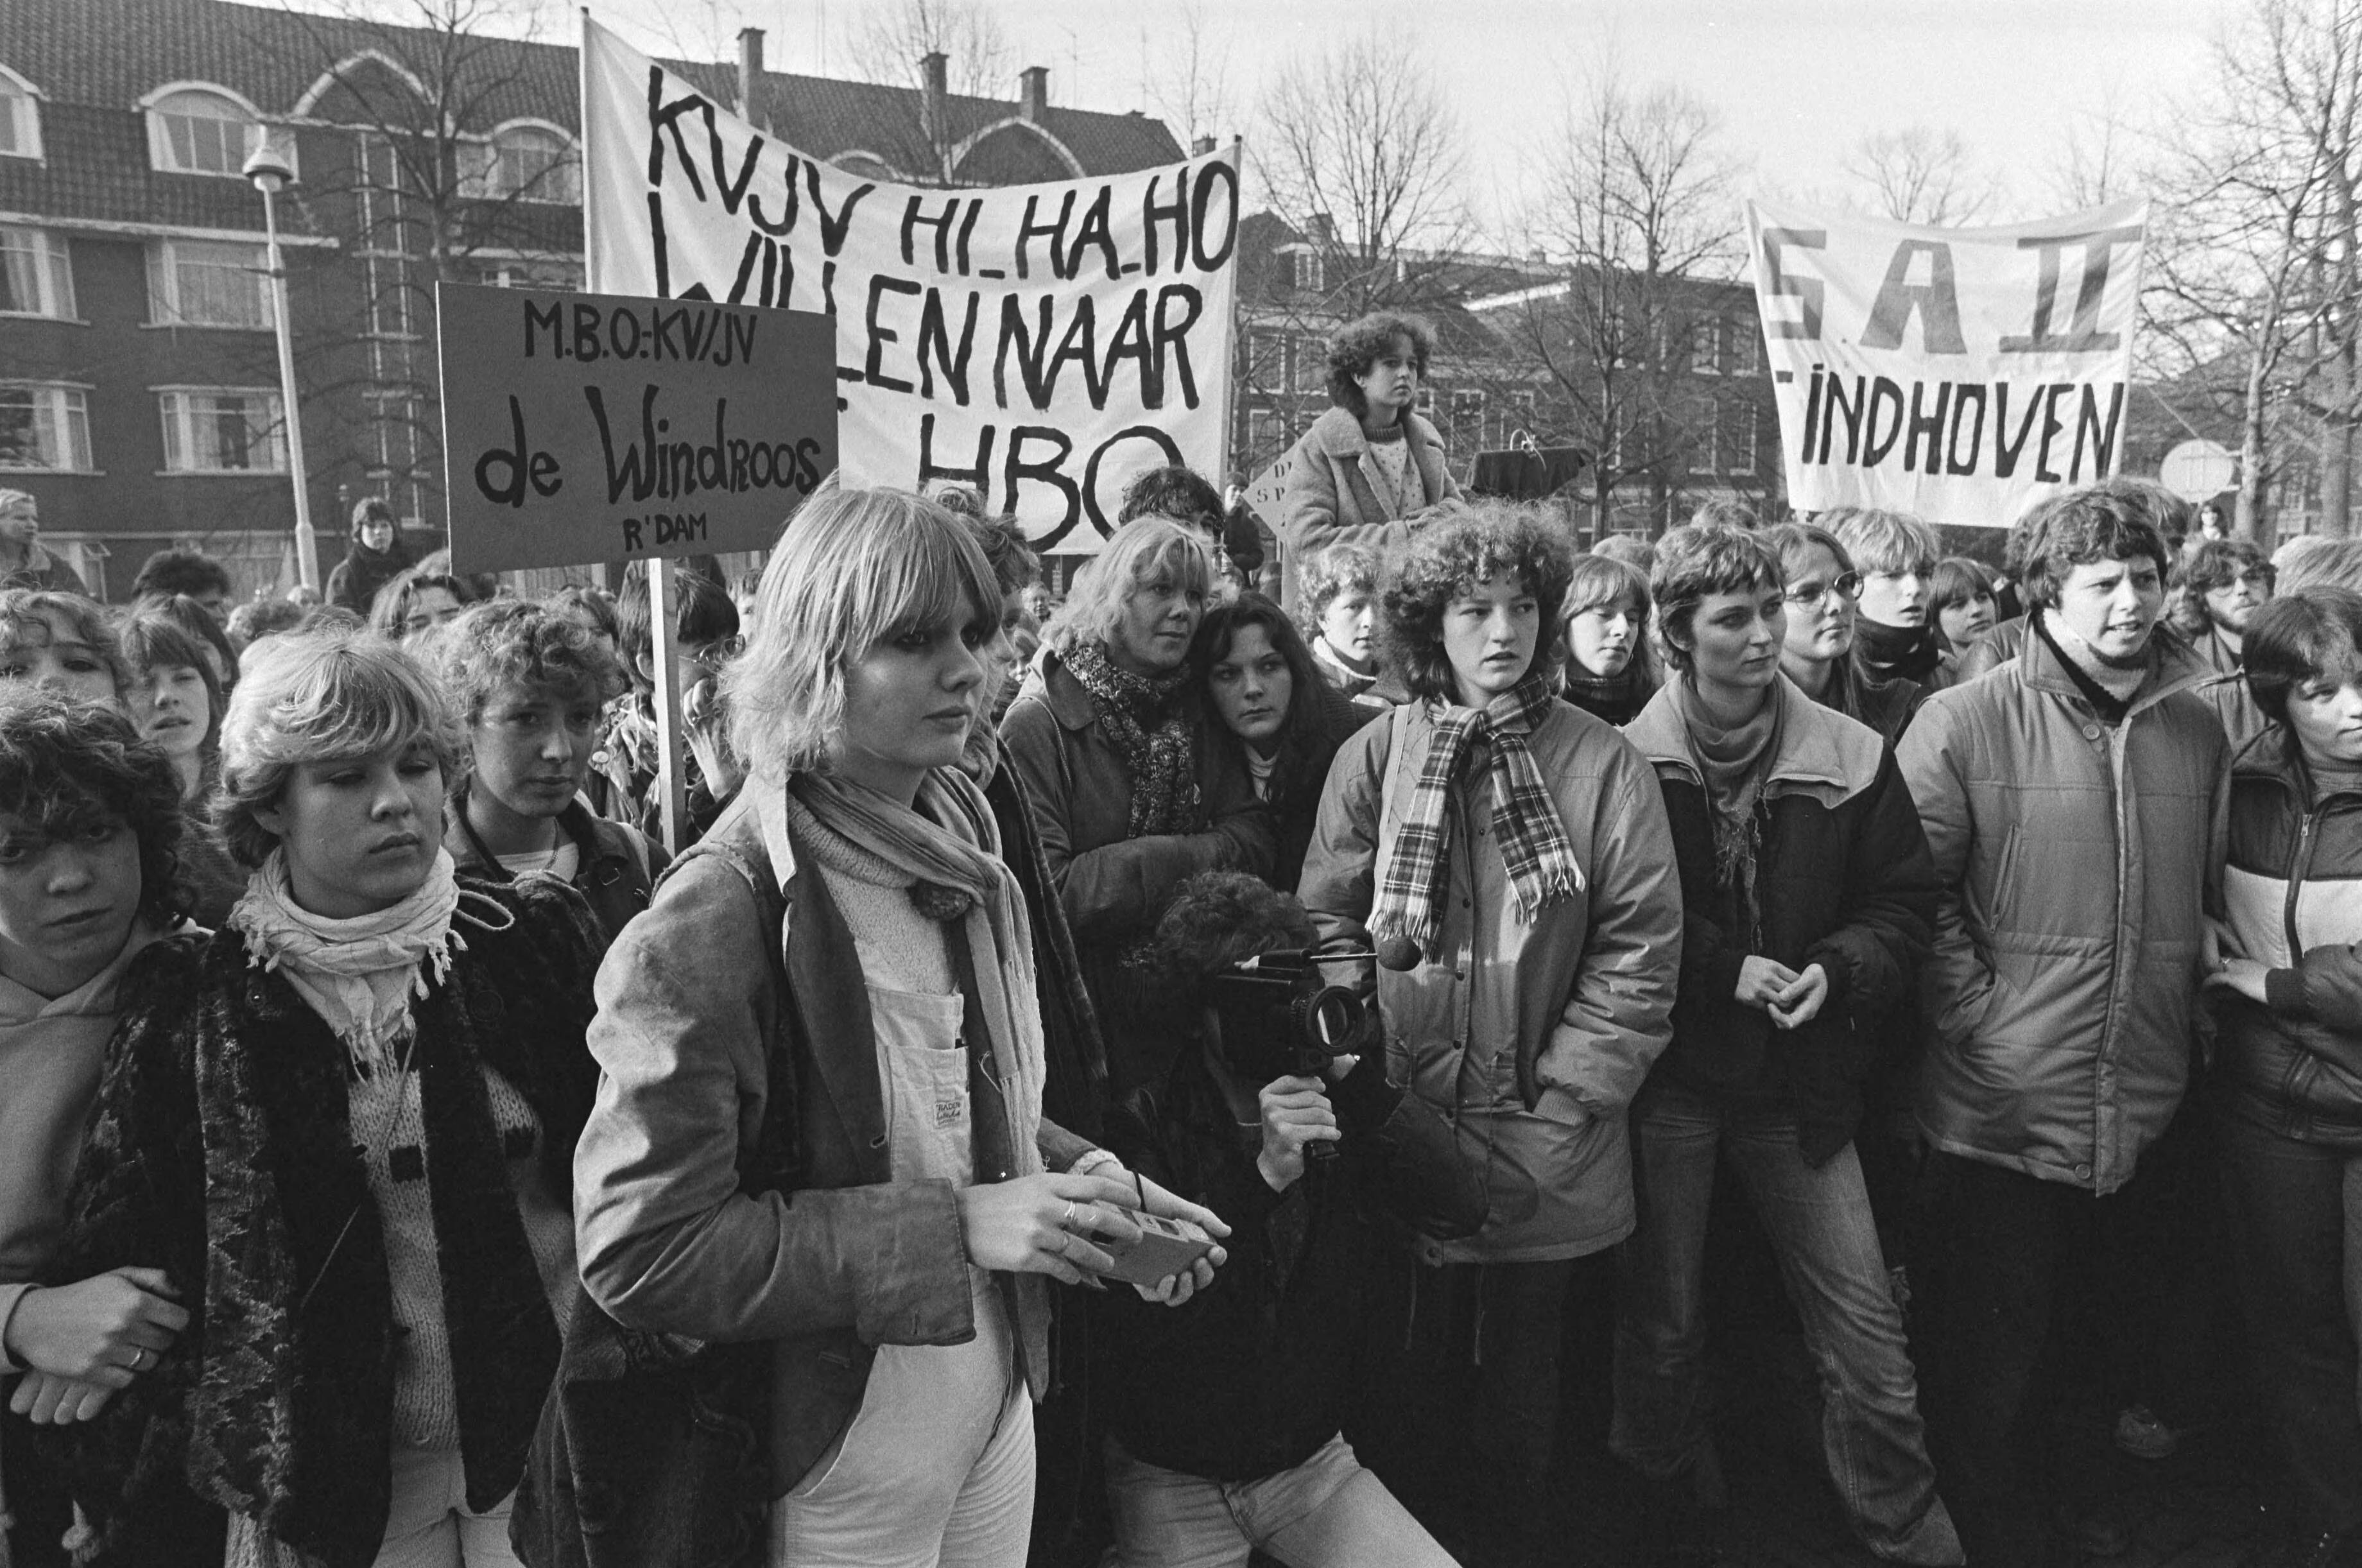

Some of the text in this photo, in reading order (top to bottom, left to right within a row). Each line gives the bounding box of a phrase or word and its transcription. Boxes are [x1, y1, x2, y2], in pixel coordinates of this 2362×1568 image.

[993, 284, 1203, 411] NAAR
[474, 394, 563, 508] de
[918, 413, 1186, 553] HBO
[623, 513, 707, 552] R'DAM
